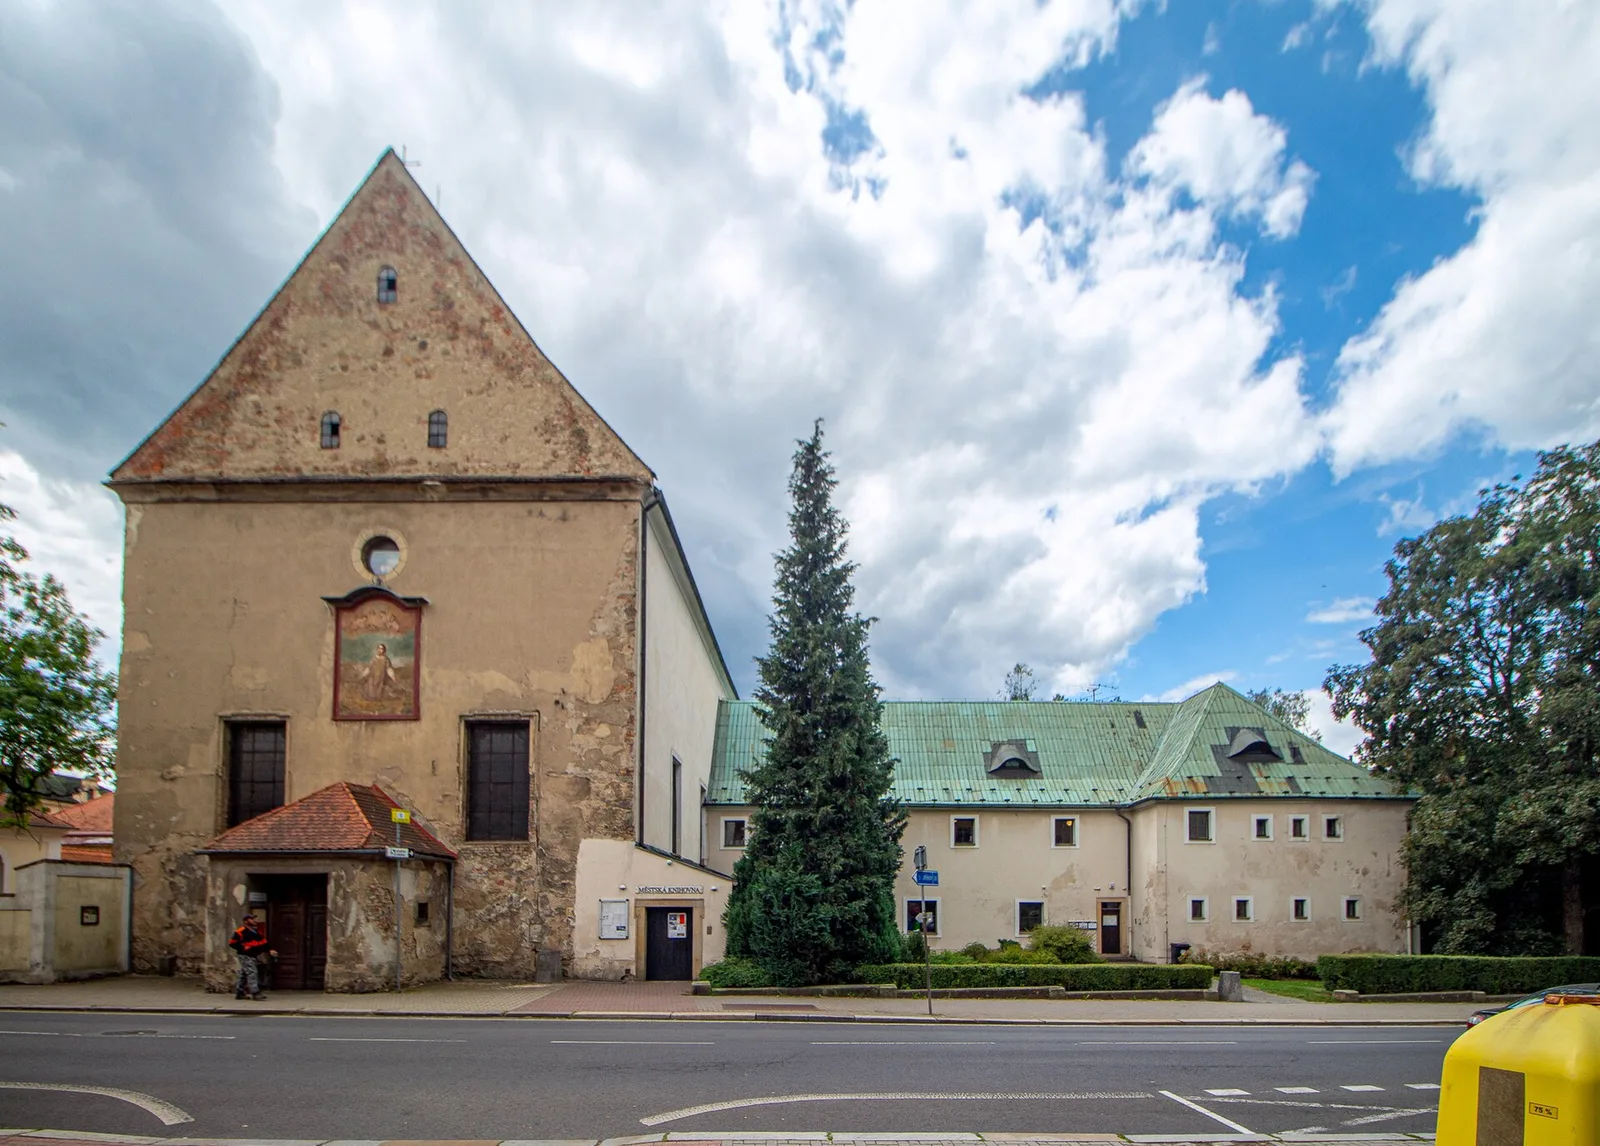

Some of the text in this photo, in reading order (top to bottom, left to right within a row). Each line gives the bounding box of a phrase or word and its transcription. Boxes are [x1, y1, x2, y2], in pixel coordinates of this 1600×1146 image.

[638, 886, 700, 894] MĚSTSKÁ KNIHOVNA
[1534, 1105, 1544, 1113] 75
